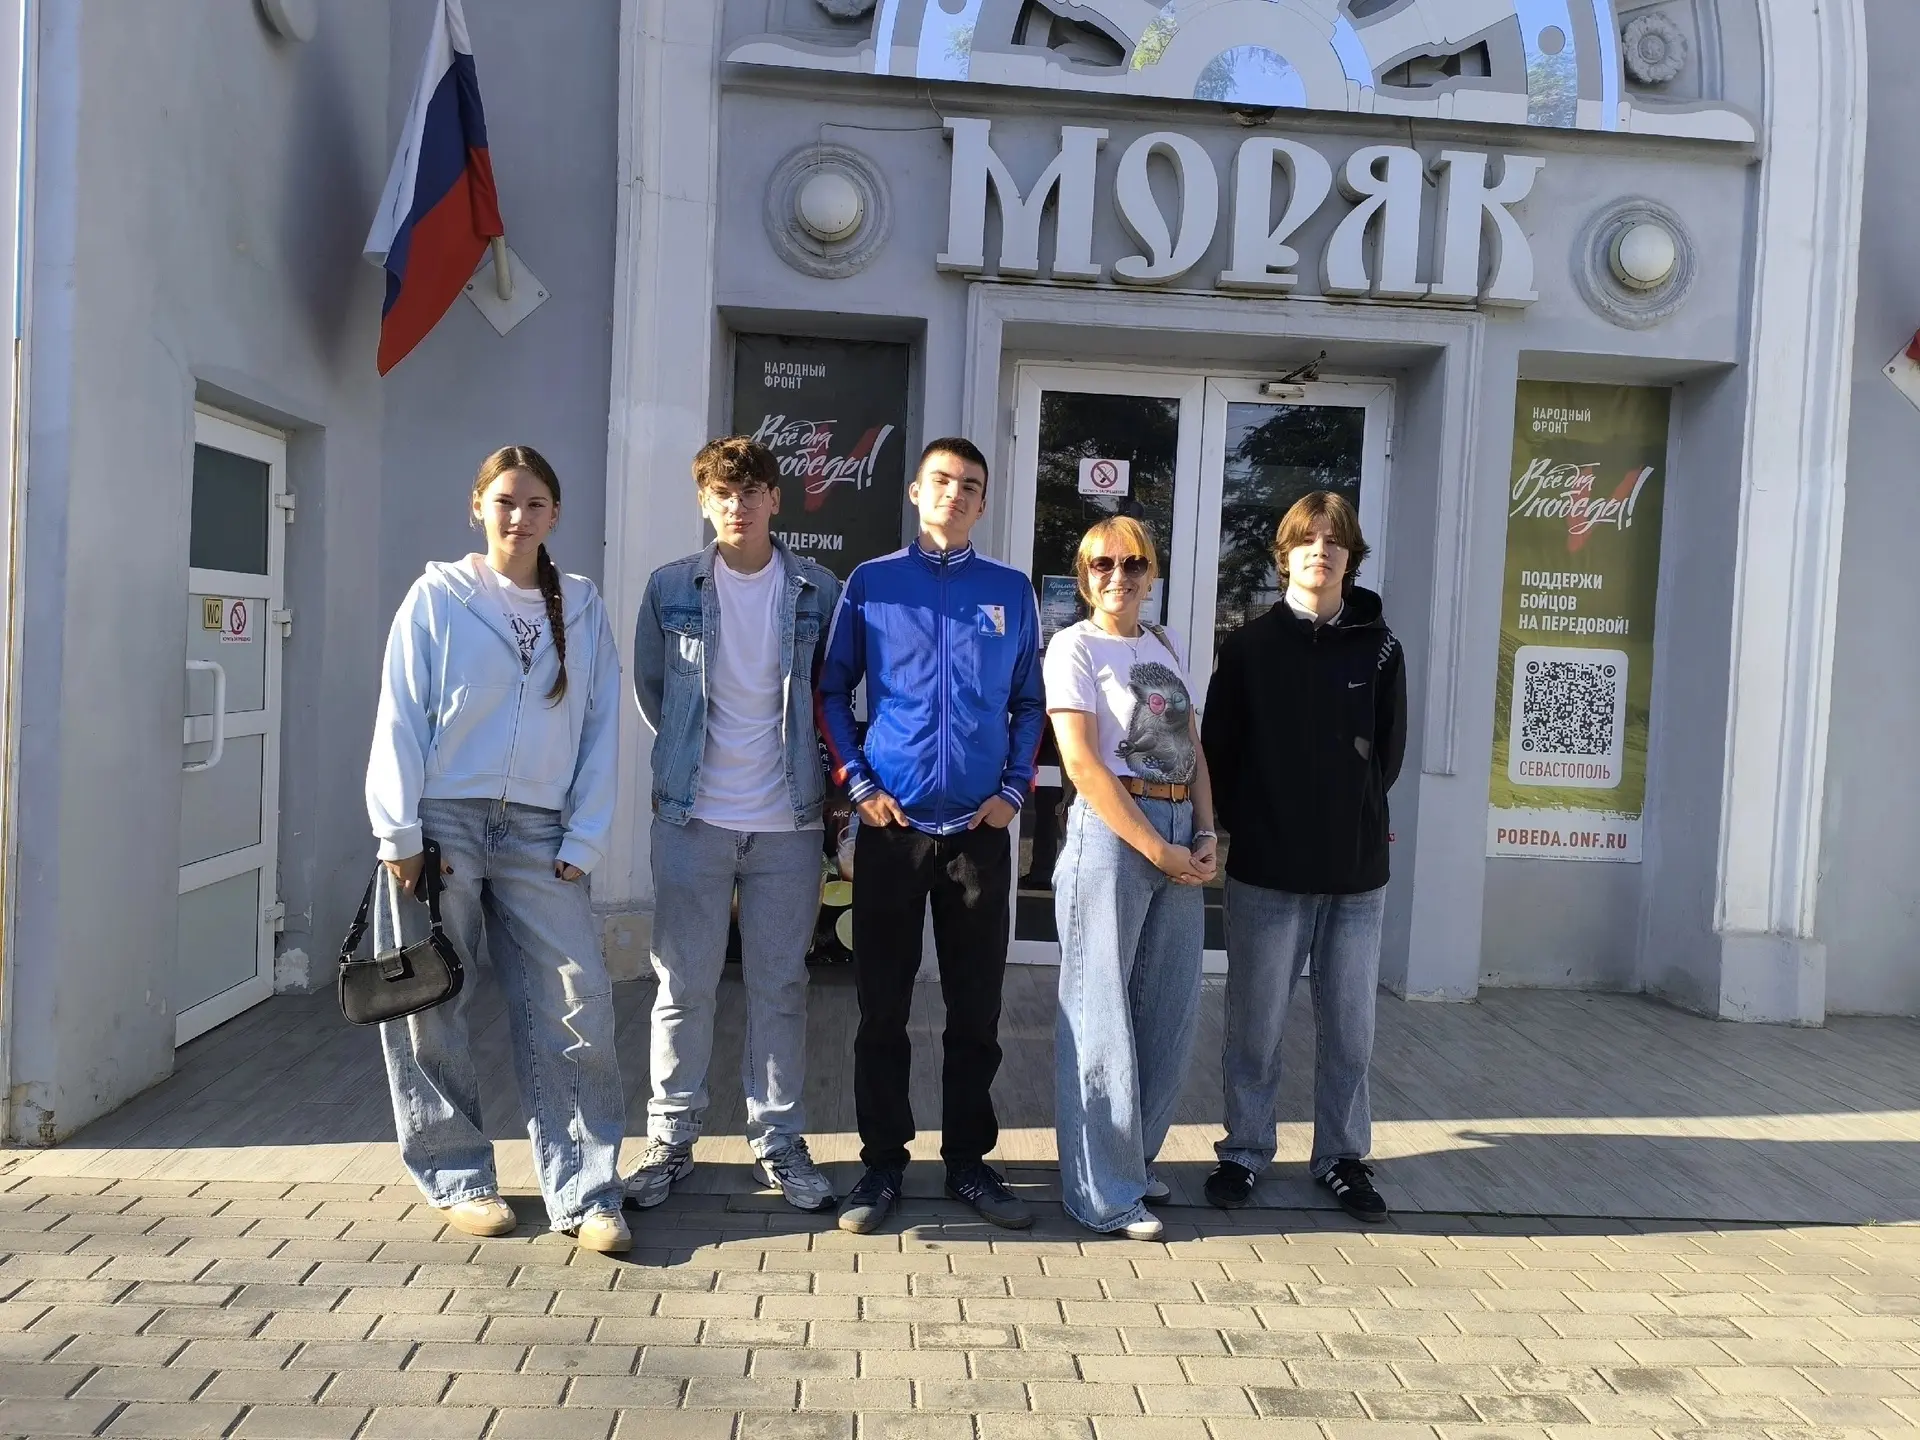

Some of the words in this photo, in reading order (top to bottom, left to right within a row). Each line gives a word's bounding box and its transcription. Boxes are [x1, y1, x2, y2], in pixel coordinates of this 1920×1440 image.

[936, 117, 1546, 309] МОРЯК
[764, 361, 826, 377] НАРОДНЫЙ
[764, 375, 803, 389] ФРОНТ
[1532, 406, 1591, 422] НАРОДНЫЙ
[783, 419, 838, 450] для
[1532, 420, 1569, 434] ФРОНТ
[775, 424, 895, 494] обеды!
[1510, 458, 1565, 517] Всё
[1547, 462, 1601, 491] для
[1524, 466, 1655, 535] победы!
[770, 531, 843, 550] ДДЕРЖИ
[1521, 570, 1603, 590] ПОДДЕРЖИ
[1520, 592, 1577, 612] БОЙЦОВ
[207, 604, 220, 624] WC
[1518, 613, 1538, 631] НА
[1541, 615, 1630, 636] ПЕРЕДОВОЙ!
[1519, 760, 1611, 780] СЕВАСТОПОЛЬ
[832, 809, 849, 818] АЙС
[1497, 828, 1627, 849] POBEDA.ONF.RU
